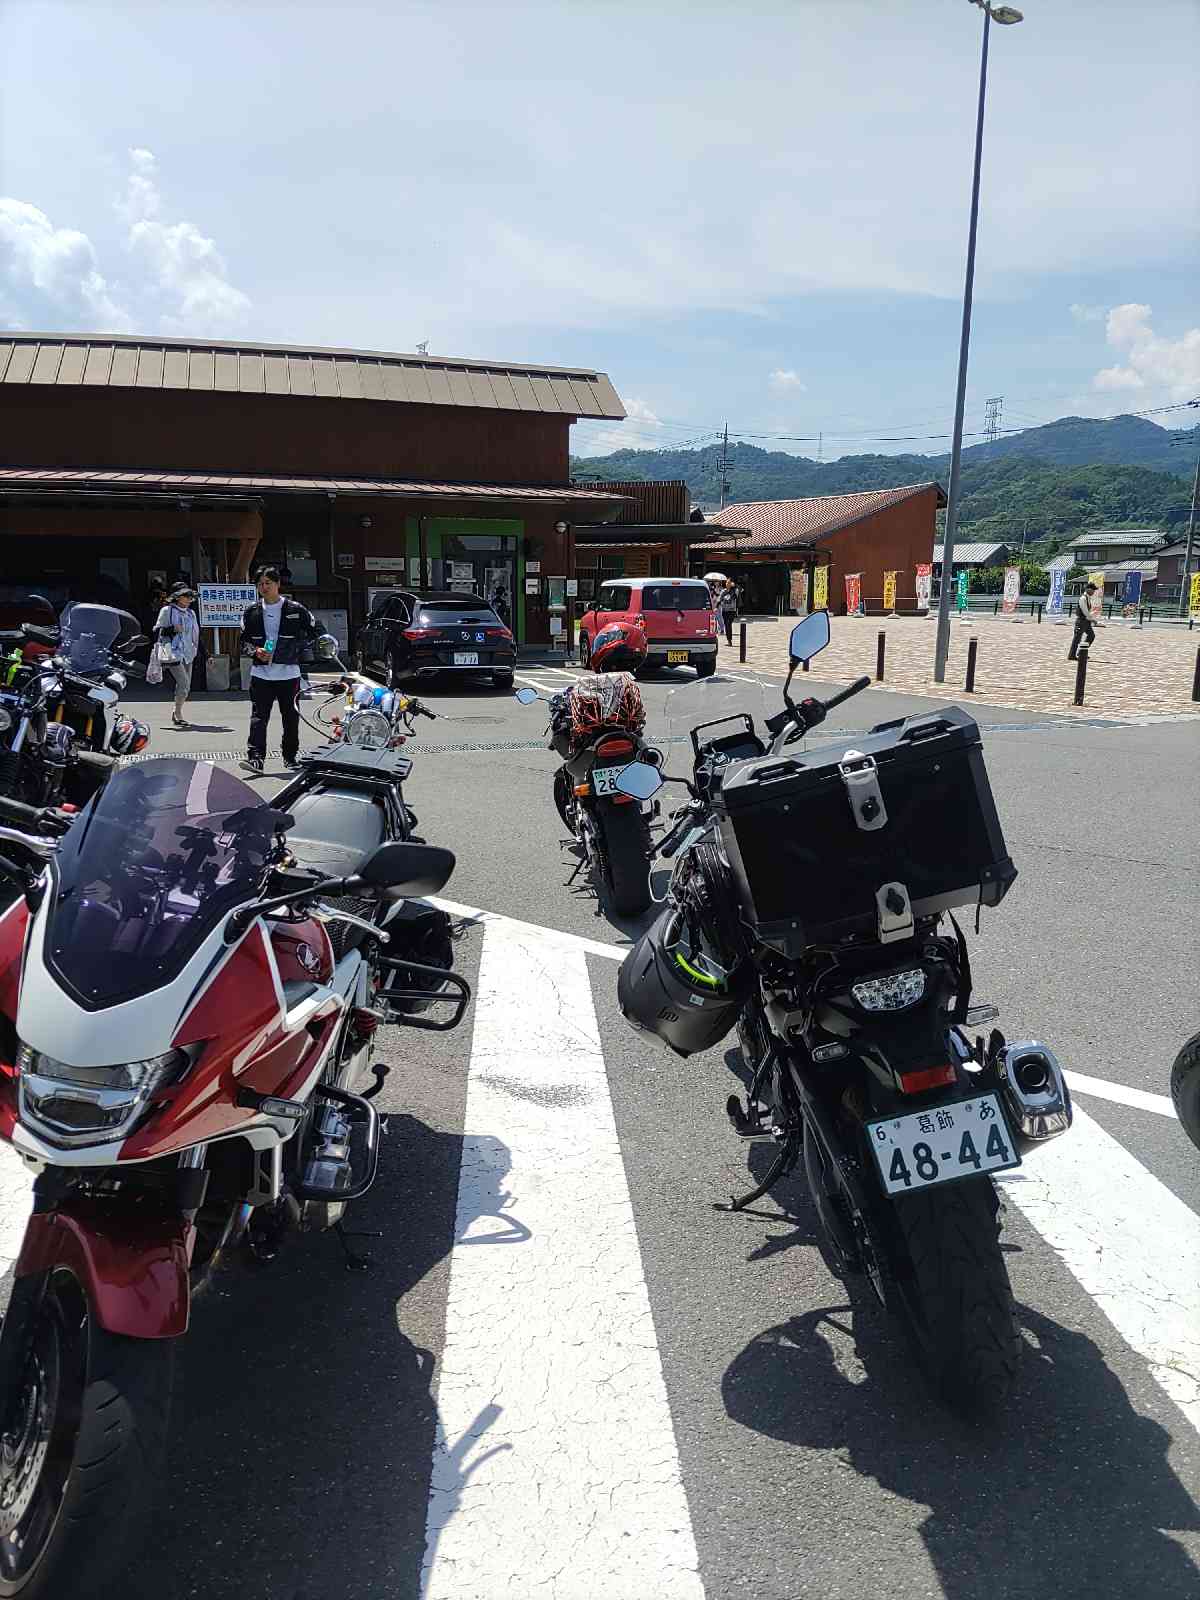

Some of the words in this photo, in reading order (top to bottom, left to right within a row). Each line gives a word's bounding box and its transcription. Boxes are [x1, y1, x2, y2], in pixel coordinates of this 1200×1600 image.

[876, 1125, 887, 1141] 6
[916, 1109, 955, 1134] 葛飾
[979, 1100, 996, 1121] あ
[889, 1123, 1009, 1187] 48-44
